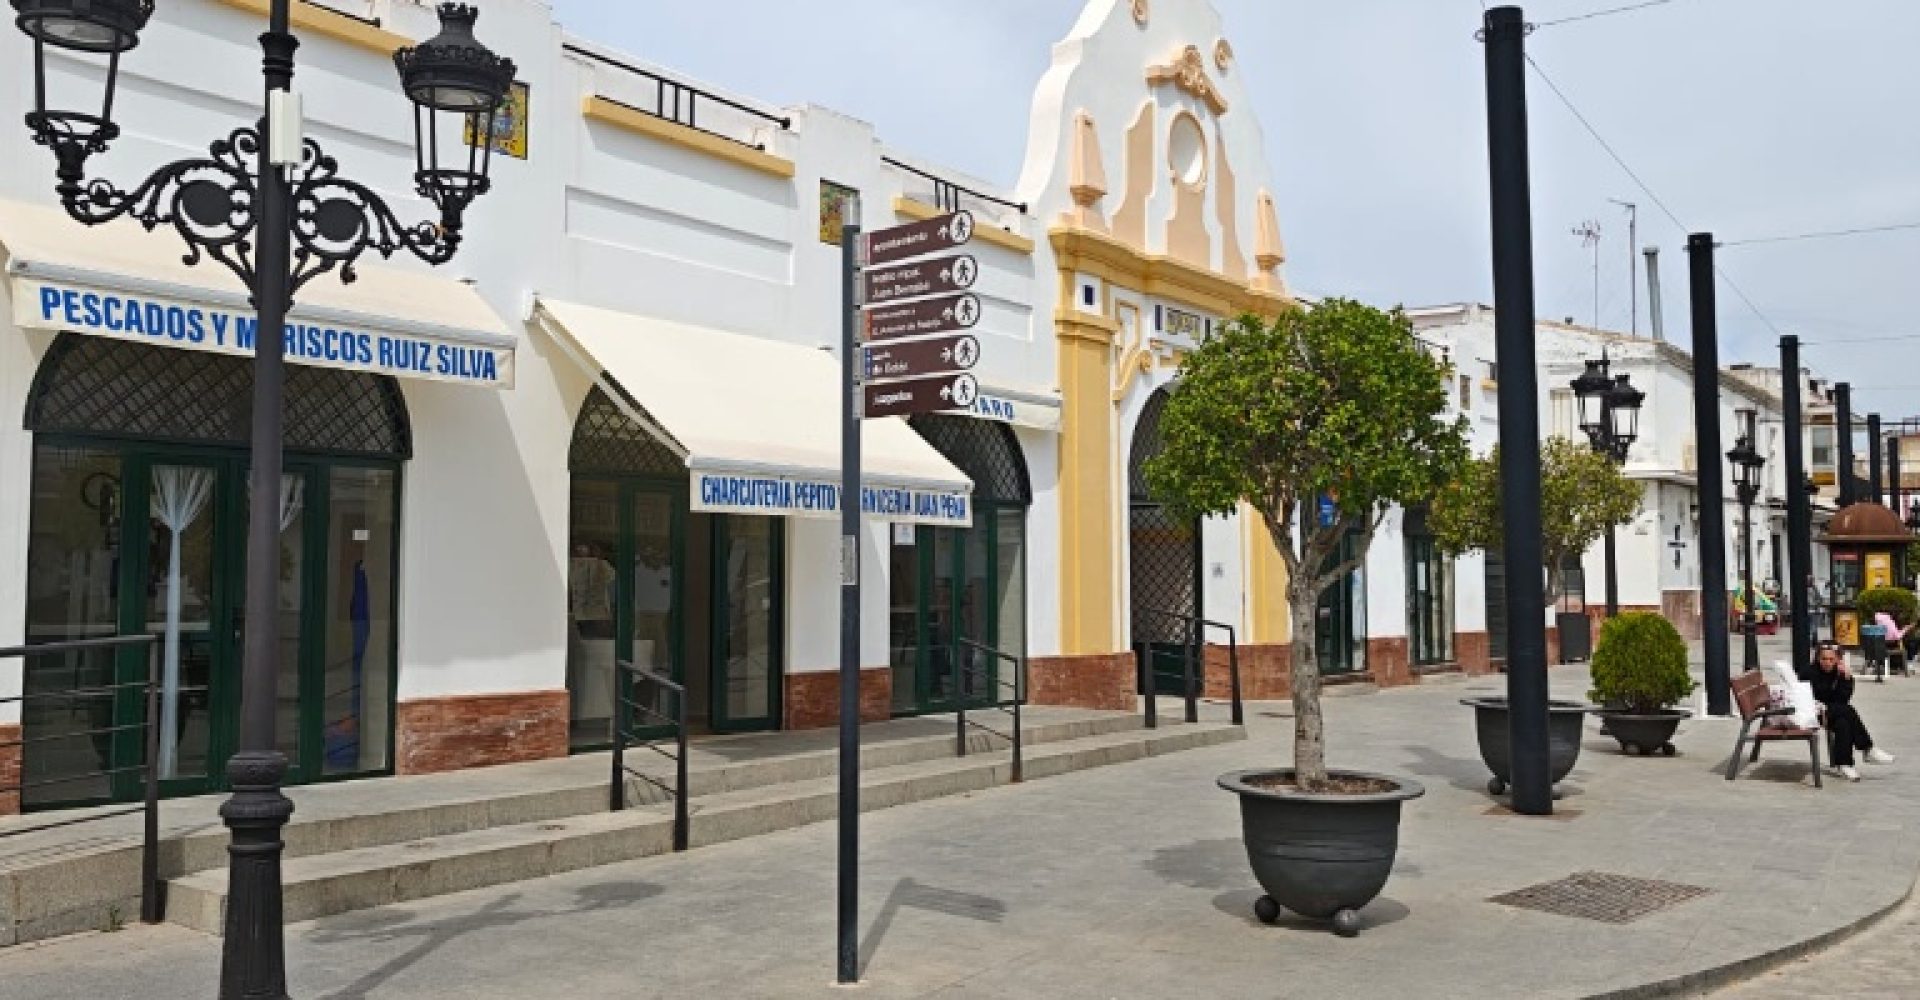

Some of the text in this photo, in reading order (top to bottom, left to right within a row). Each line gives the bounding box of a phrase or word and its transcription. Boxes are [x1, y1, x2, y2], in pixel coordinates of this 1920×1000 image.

[40, 286, 496, 381] PESCADOS Y MRISCOS RUIZ SILVA
[795, 481, 836, 511] PEPITO
